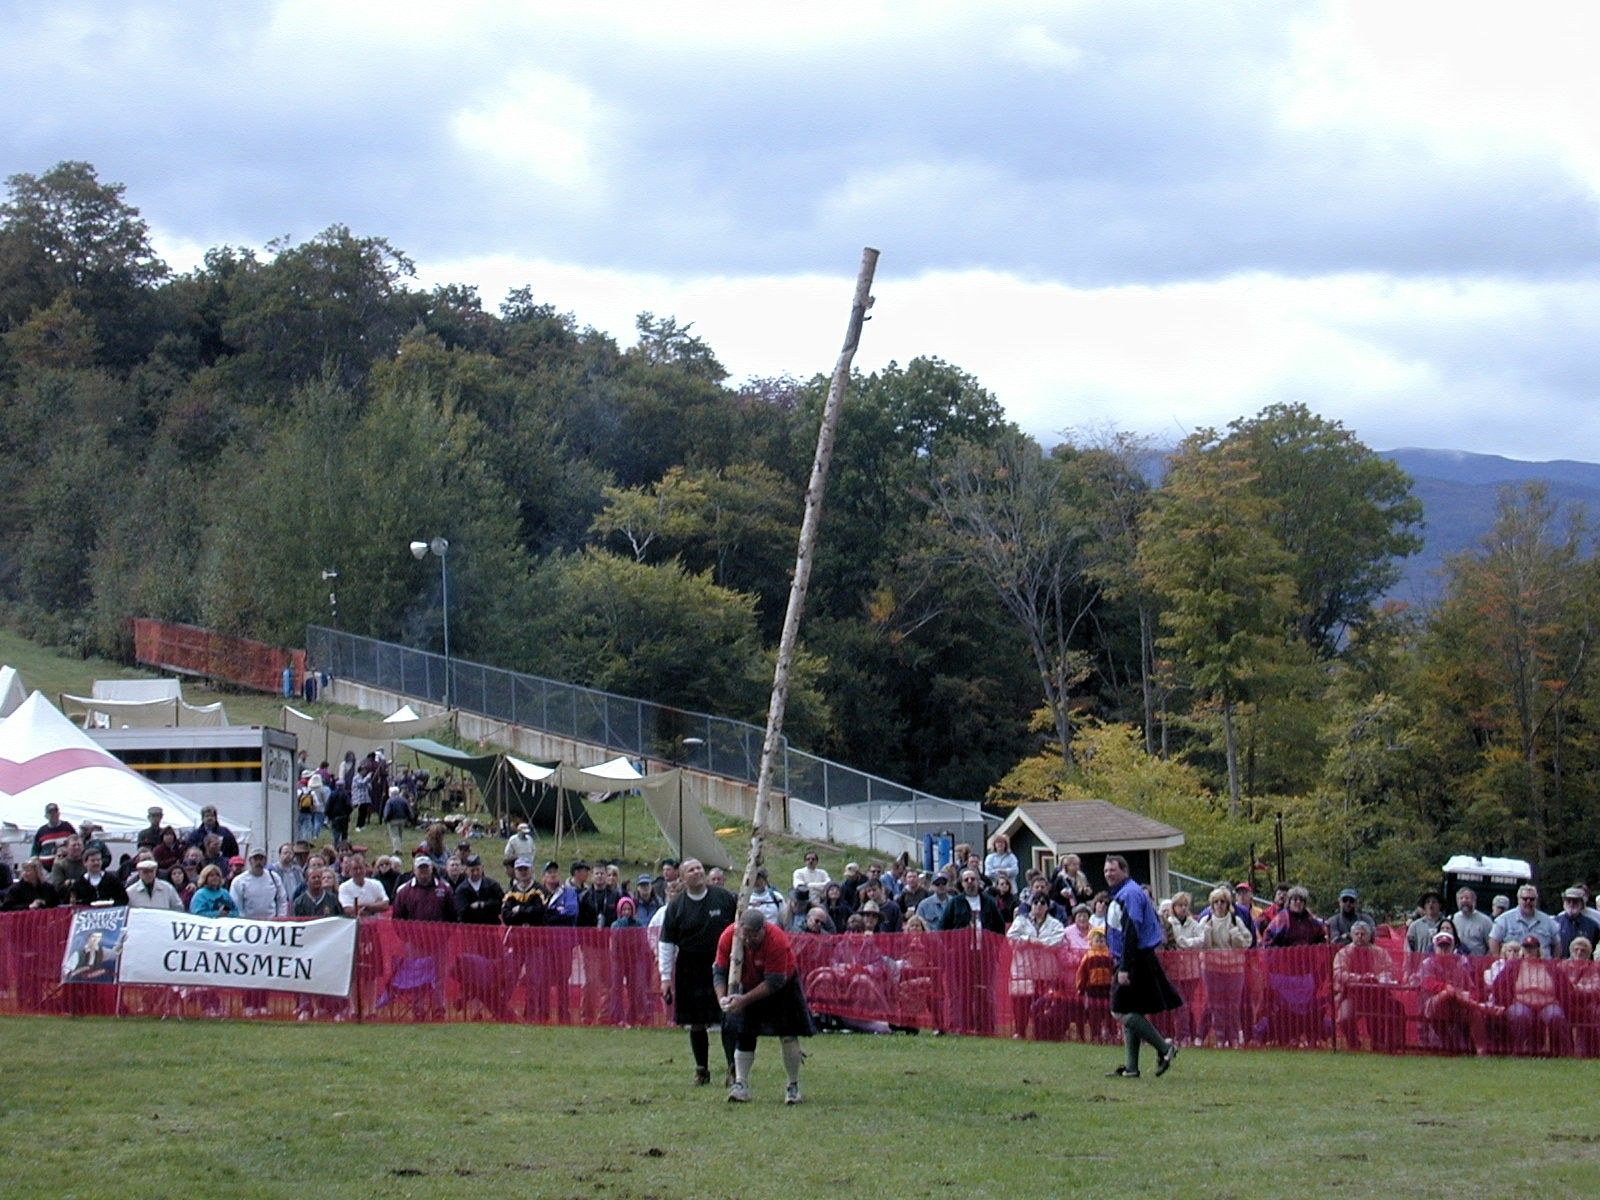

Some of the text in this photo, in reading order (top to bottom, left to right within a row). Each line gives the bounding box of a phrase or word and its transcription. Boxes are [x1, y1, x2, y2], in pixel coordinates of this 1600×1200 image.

[75, 910, 124, 924] SAMUEL
[75, 919, 117, 934] ADAMS
[171, 921, 306, 948] WELCOME
[163, 950, 313, 980] CLANSMEN
